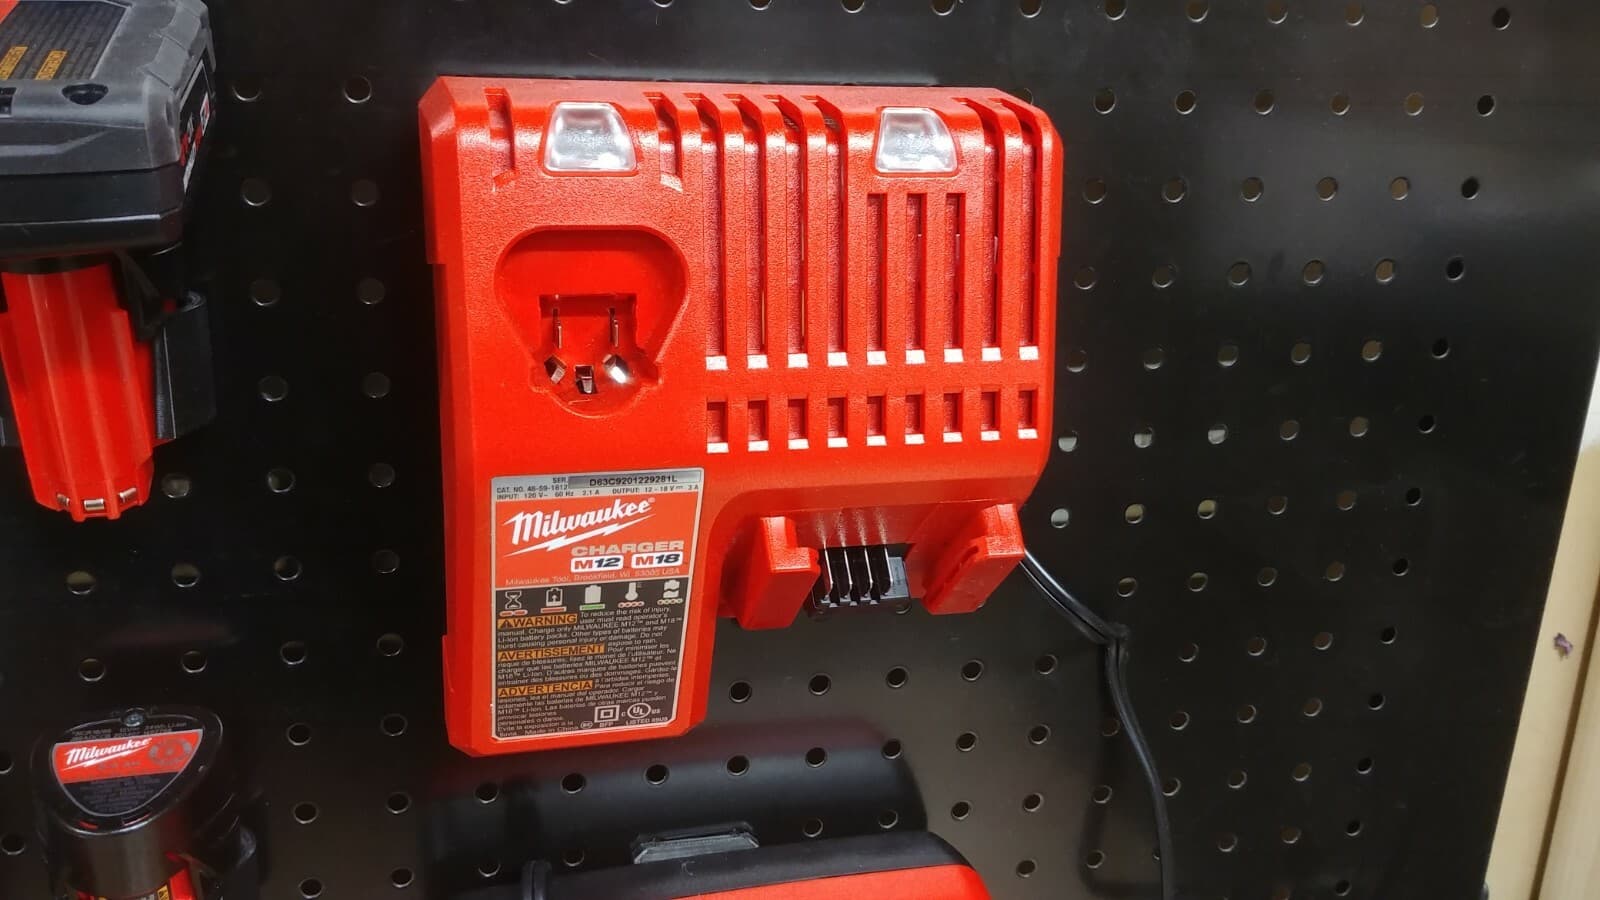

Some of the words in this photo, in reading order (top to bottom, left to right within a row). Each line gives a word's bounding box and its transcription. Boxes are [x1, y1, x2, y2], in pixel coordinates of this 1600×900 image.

[571, 541, 684, 557] CHARGER
[574, 558, 620, 570] M12
[636, 554, 680, 566] M18
[512, 614, 576, 628] WARNING
[574, 622, 619, 631] MILWAUKEE
[500, 644, 604, 661] AVERTISSEMENT
[500, 681, 592, 696] ADVERTENCIA
[632, 706, 646, 716] UL
[64, 737, 152, 766] Milwaukee
